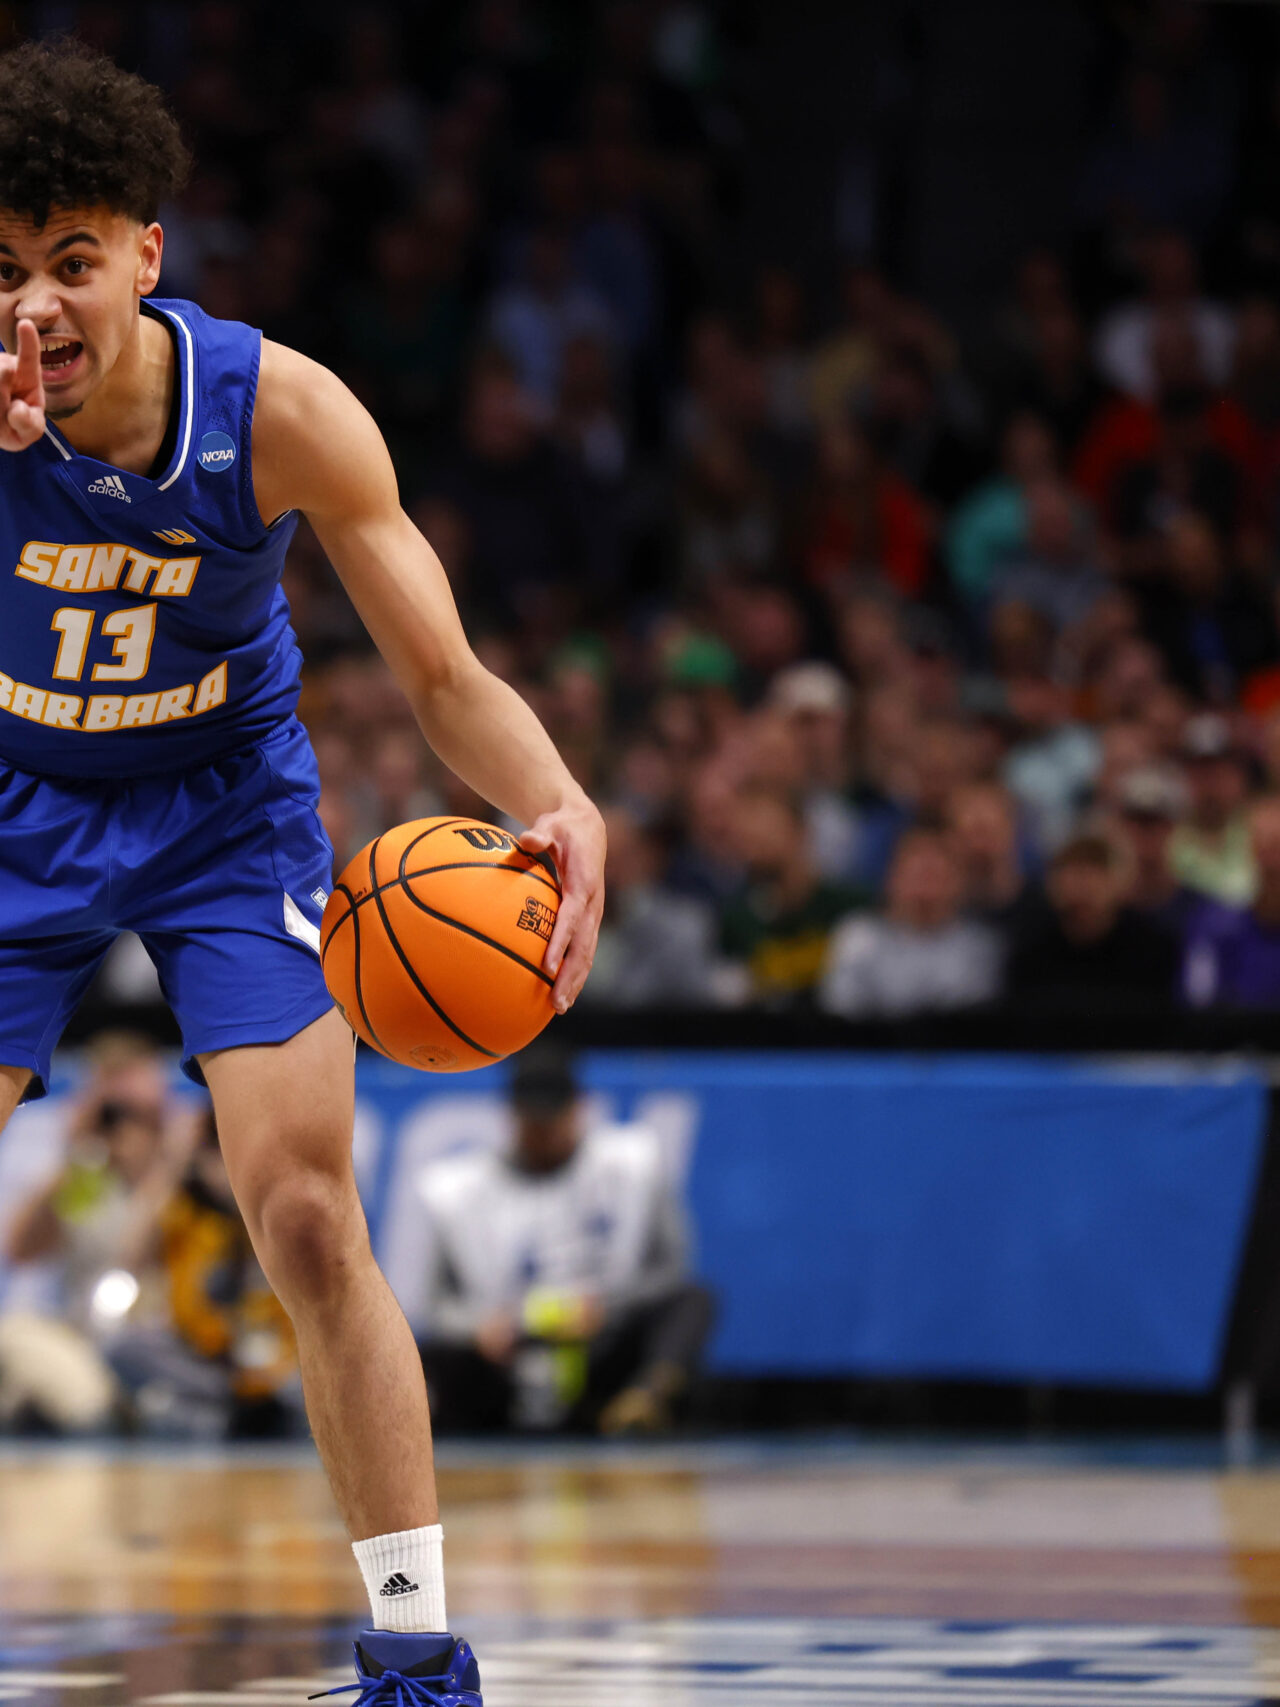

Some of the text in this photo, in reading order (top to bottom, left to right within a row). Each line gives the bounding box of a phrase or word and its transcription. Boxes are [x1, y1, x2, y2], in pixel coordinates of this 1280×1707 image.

[202, 449, 234, 463] NCAA
[87, 484, 132, 504] adidas
[15, 541, 202, 596] SANTA
[51, 603, 158, 682] 13
[379, 1583, 419, 1596] adidas
